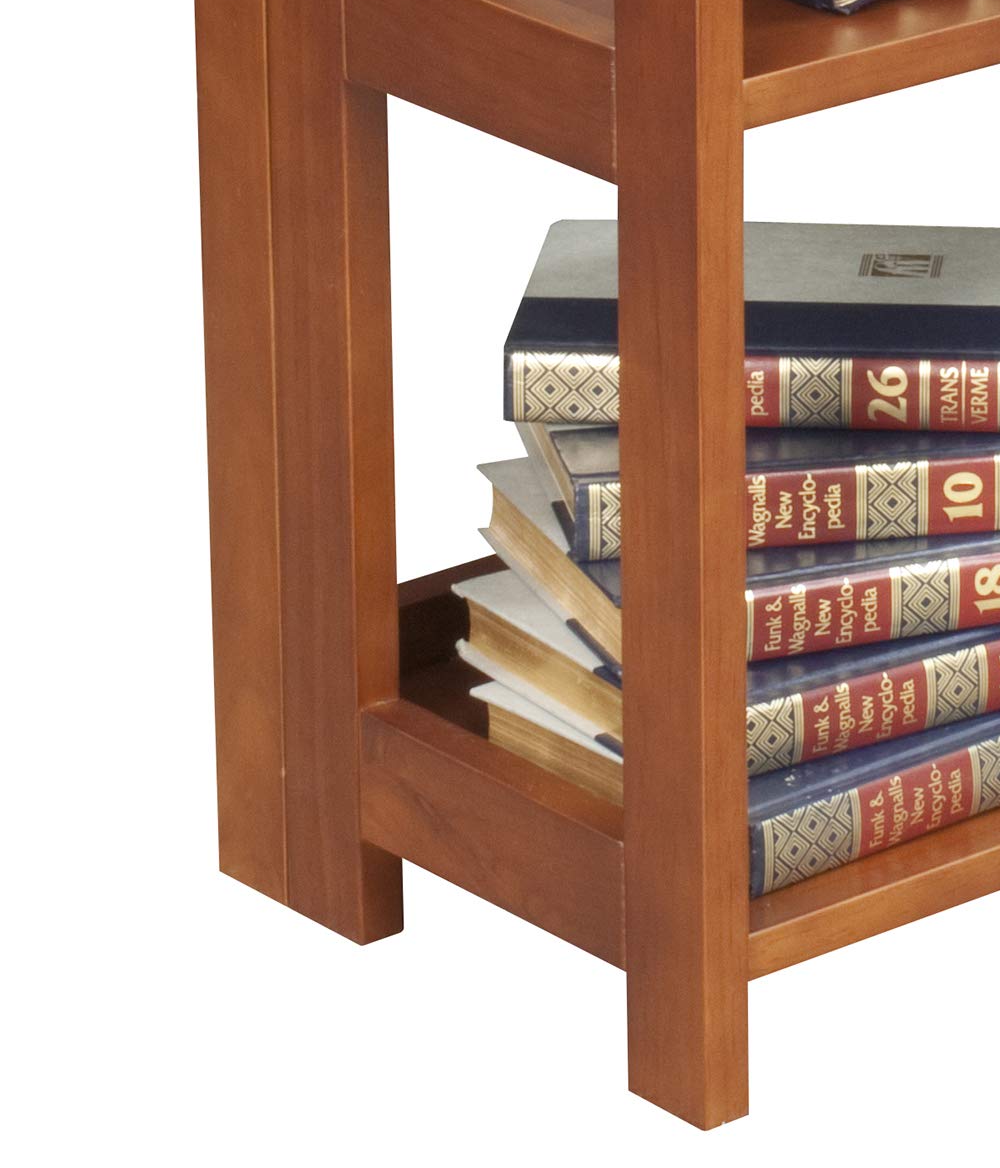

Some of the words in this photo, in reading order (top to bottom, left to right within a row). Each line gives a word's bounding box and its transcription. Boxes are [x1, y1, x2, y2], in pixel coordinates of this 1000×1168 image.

[747, 370, 768, 416] pedia
[866, 365, 909, 424] 26
[941, 366, 960, 424] TRANS
[970, 366, 989, 425] VERME
[747, 474, 772, 547] Wagnalls
[775, 491, 793, 529] New
[798, 472, 821, 540] Encyclo-
[824, 484, 845, 530] pedia
[942, 472, 984, 523] 10
[765, 596, 782, 613] &
[788, 583, 811, 656] Wagnalls
[814, 598, 832, 636] New
[836, 577, 858, 644] Encyclo-
[861, 586, 881, 633] pedia
[764, 615, 782, 652] Funk
[813, 696, 829, 713] &
[833, 682, 856, 755] Wagnalls
[858, 695, 874, 734] New
[876, 672, 898, 739] Encyclo-
[900, 679, 918, 725] pedia
[813, 716, 830, 754] Funk
[869, 791, 885, 808] &
[887, 775, 909, 847] Wagnalls
[911, 787, 925, 825] New
[927, 763, 946, 830] Encyclo-
[948, 768, 964, 814] pedia
[869, 814, 885, 849] Funk
